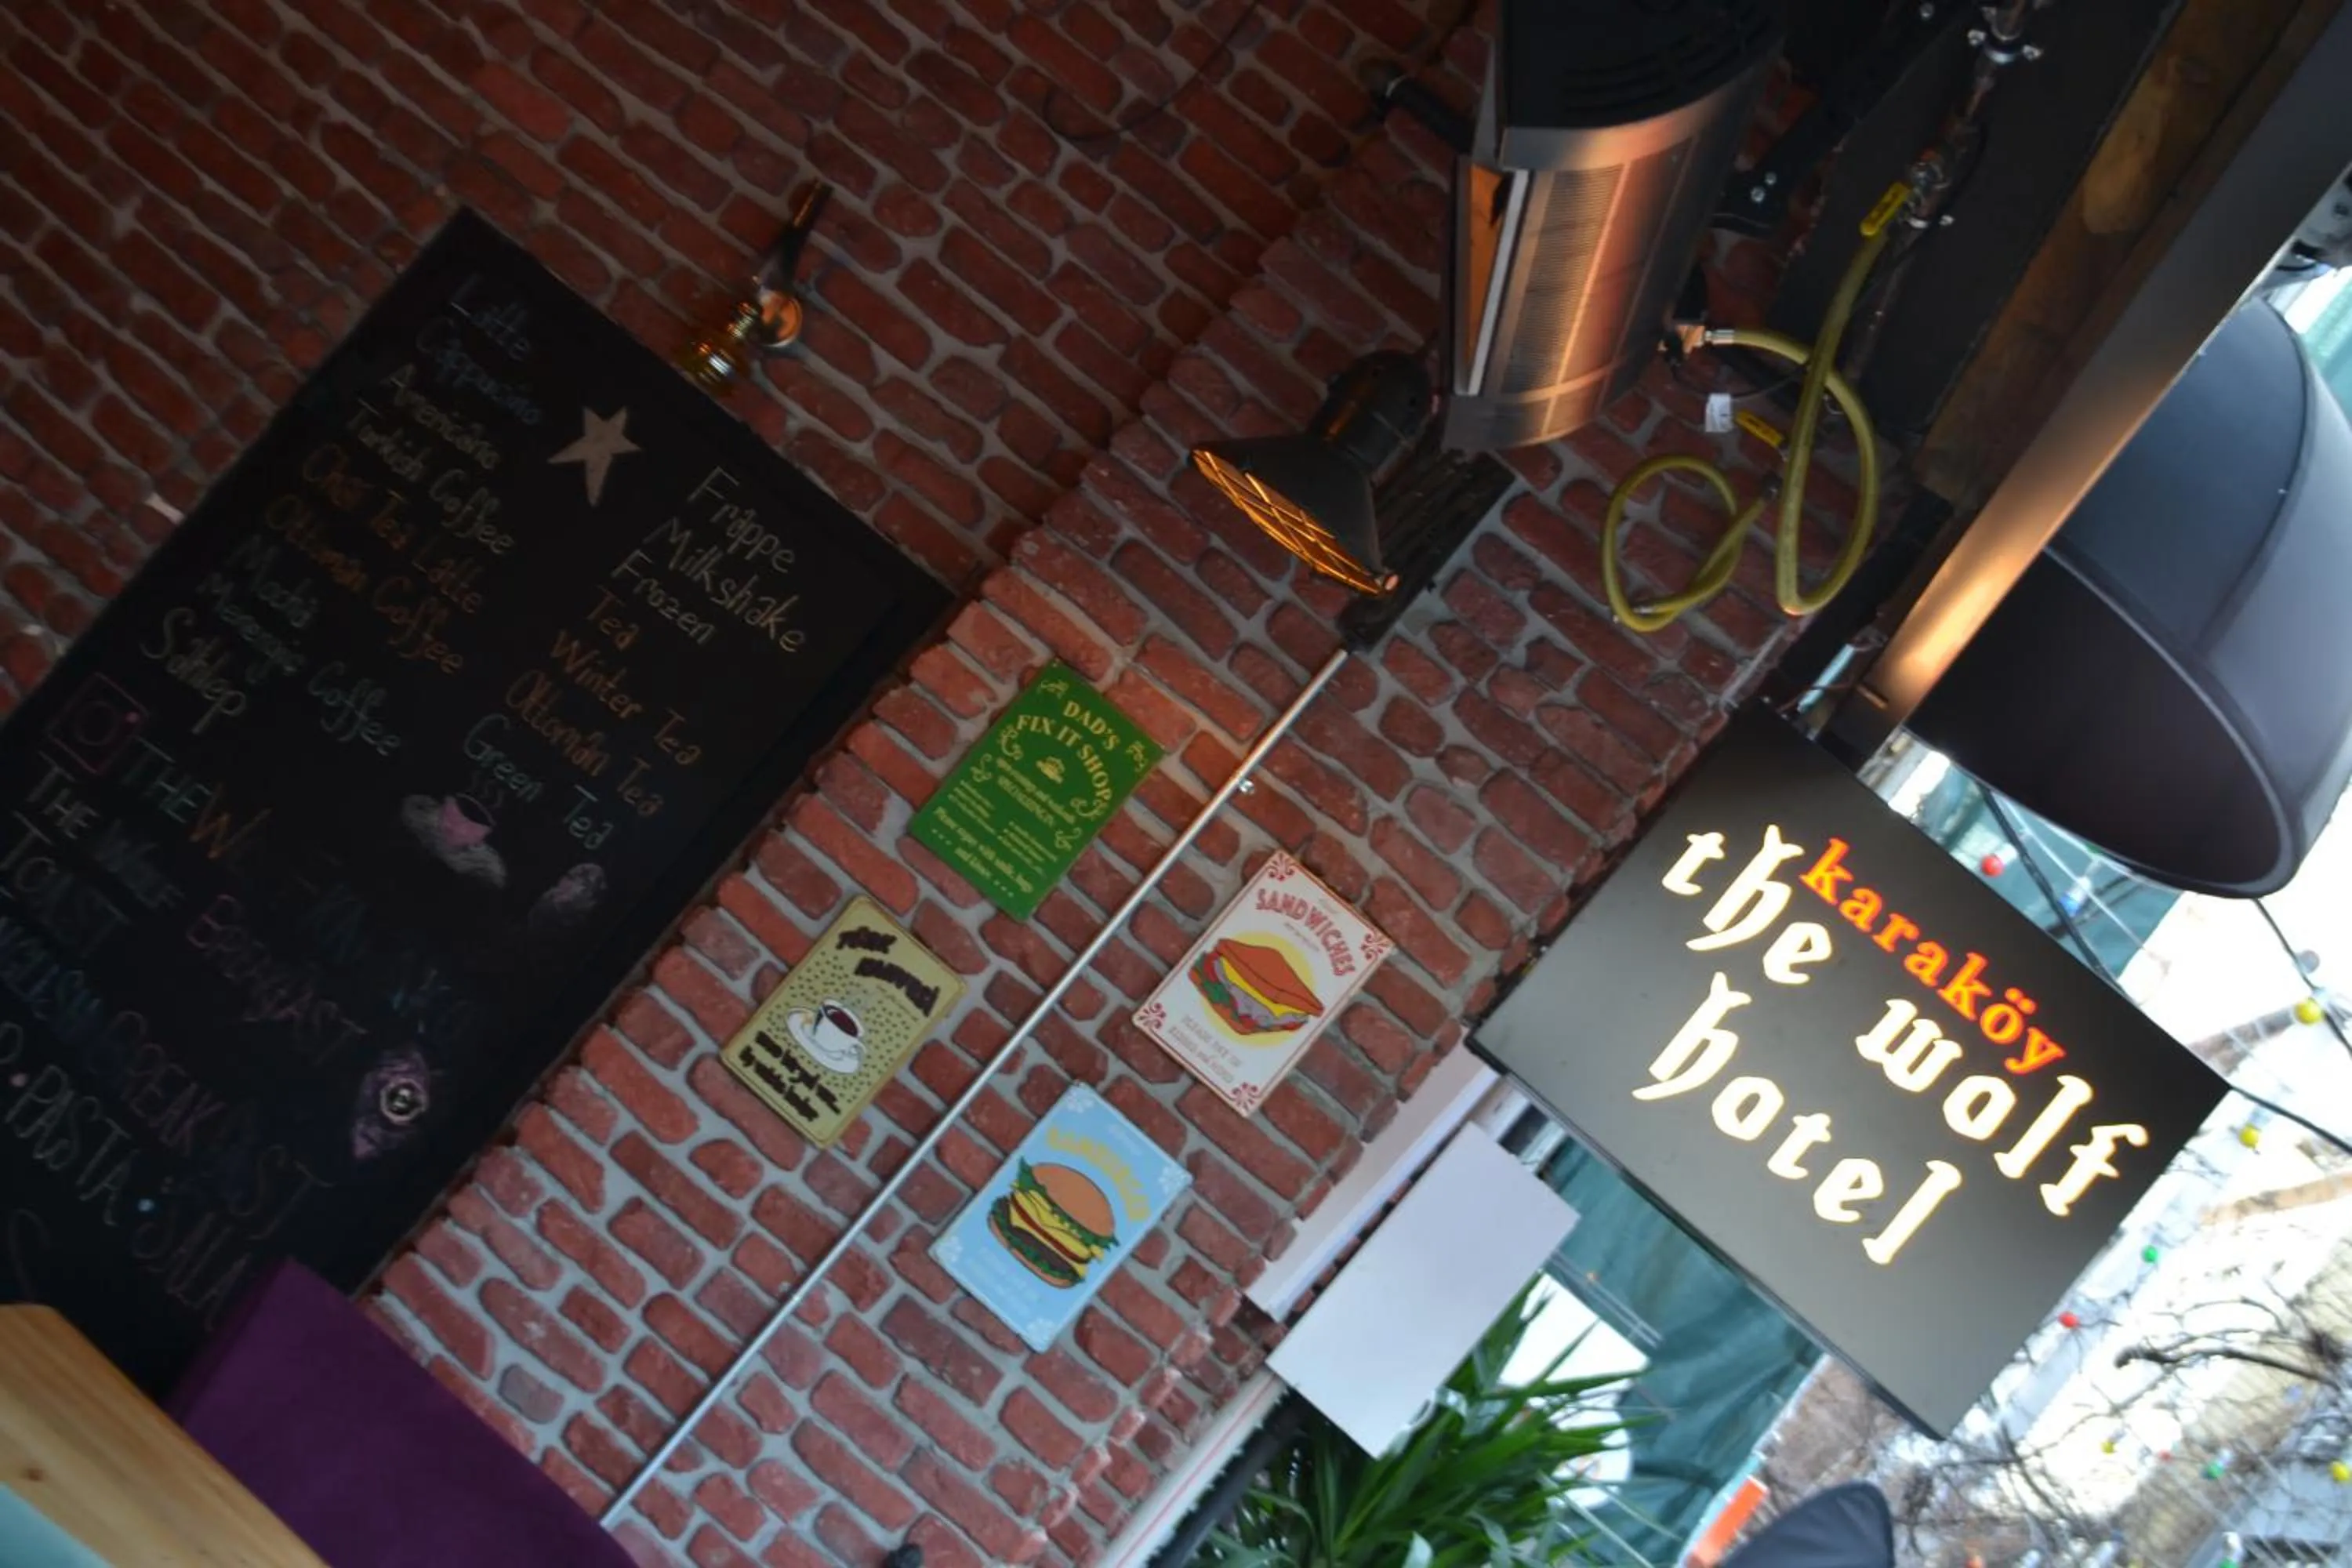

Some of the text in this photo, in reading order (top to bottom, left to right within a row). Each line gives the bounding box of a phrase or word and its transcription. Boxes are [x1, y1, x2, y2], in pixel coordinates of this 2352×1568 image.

[449, 271, 531, 361] Latte
[347, 397, 515, 555] Turkish Coffee
[375, 575, 464, 676] Coffee
[410, 541, 484, 614] Latte
[586, 588, 640, 651] Tea
[611, 548, 715, 645] Frozen
[637, 517, 806, 653] Milkshake
[307, 661, 401, 757] Coffee
[506, 673, 665, 817] Ottoman Tea
[550, 630, 702, 766] Winter Tea
[1062, 700, 1120, 750] DAD'S
[463, 712, 615, 850] Green Tea
[1015, 714, 1112, 804] FIX IT SHOP
[1256, 887, 1356, 977] SANDWICHES
[1798, 837, 2065, 1076] karaköy
[1661, 824, 2147, 1216] the wolf
[1632, 971, 1962, 1265] hotel
